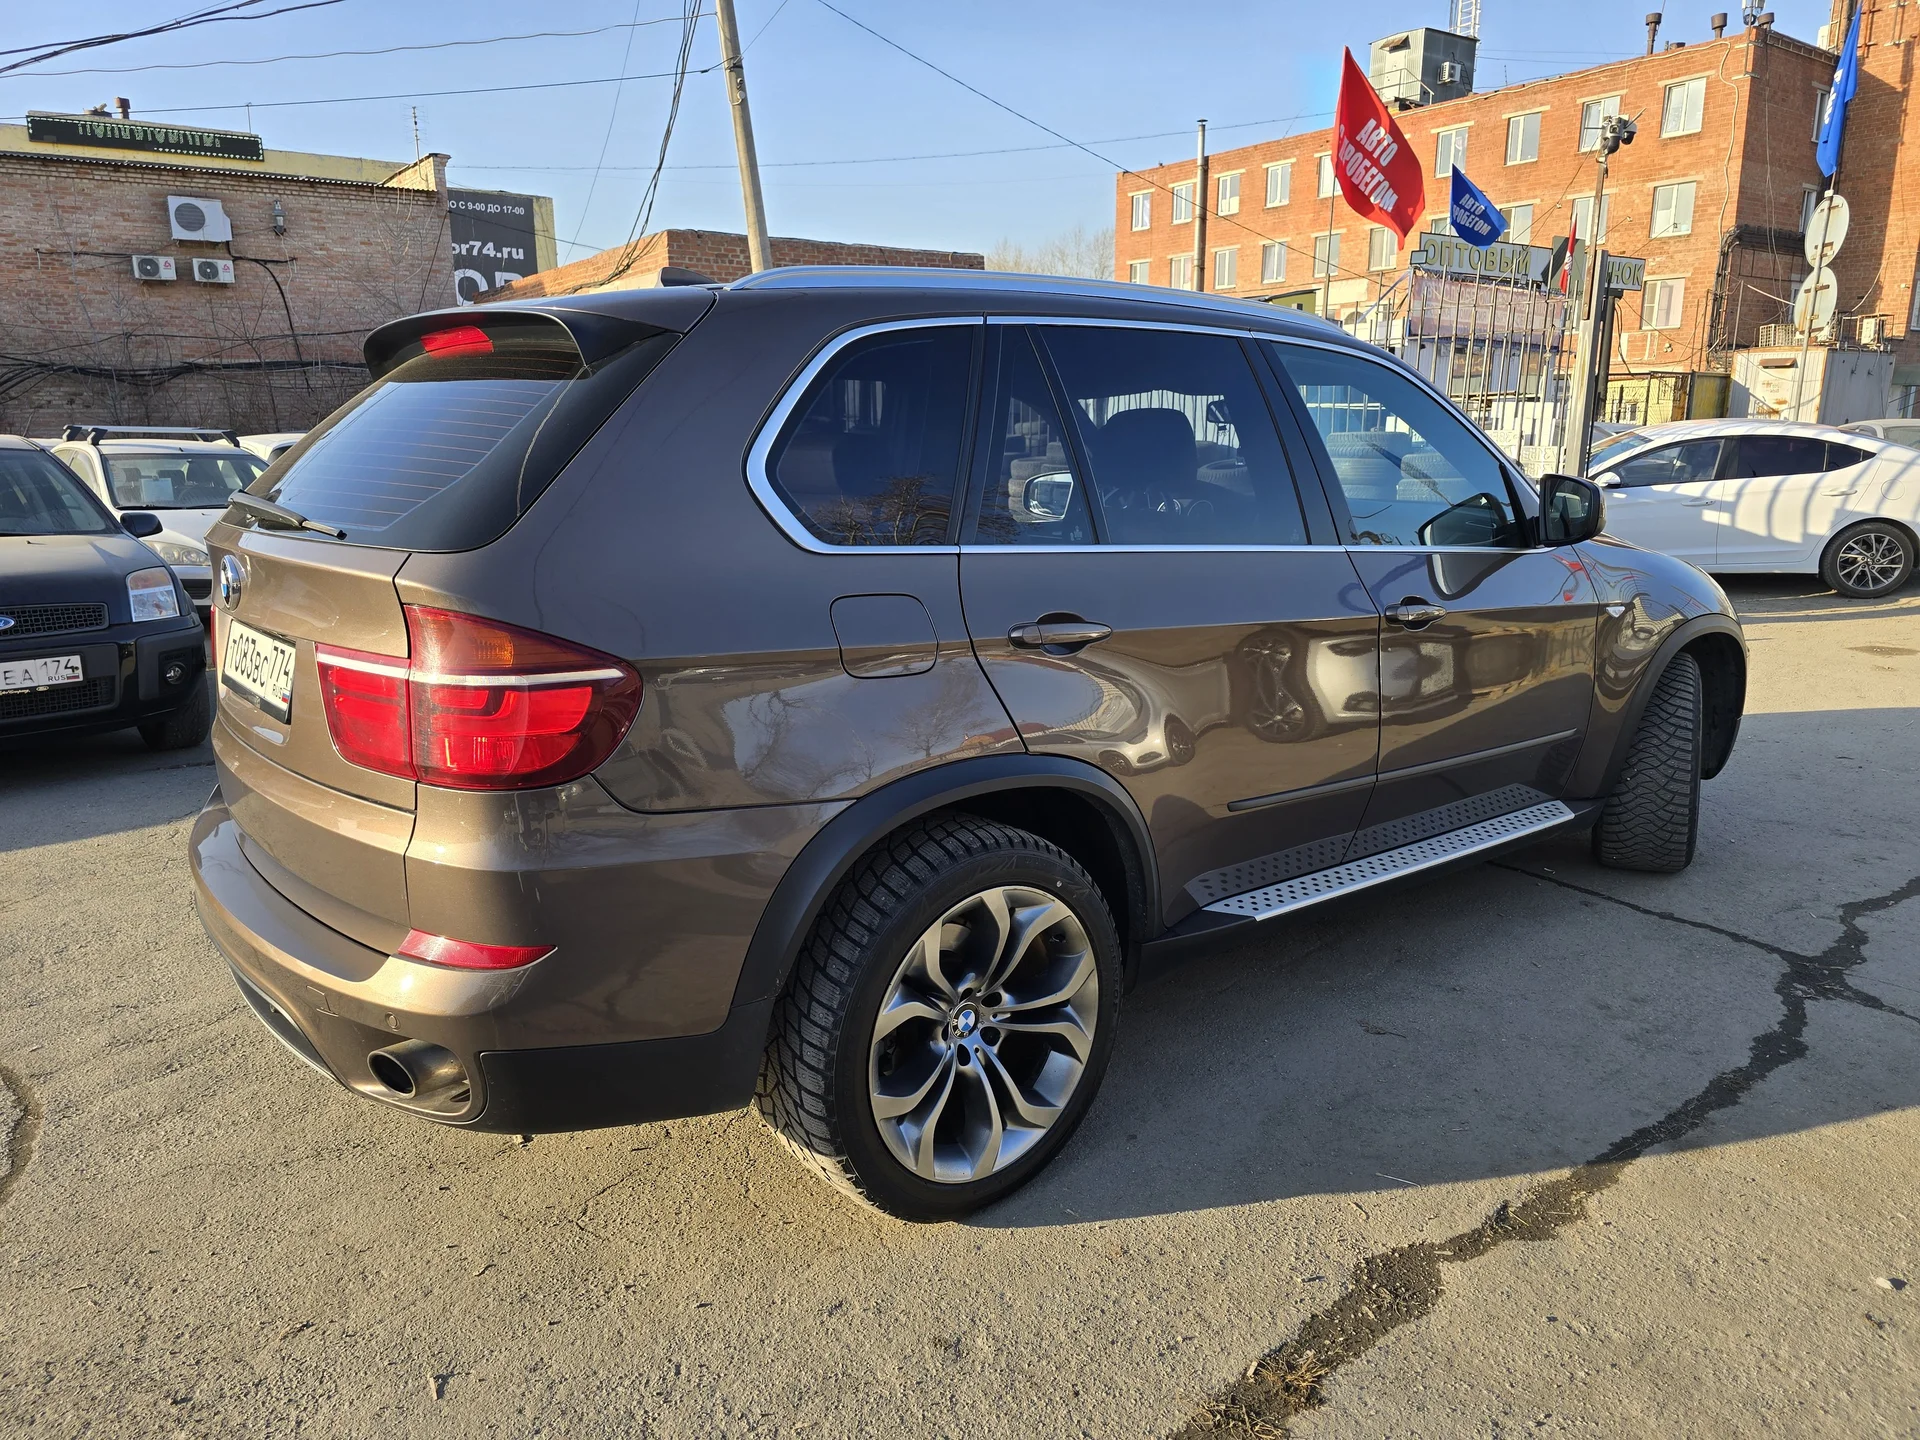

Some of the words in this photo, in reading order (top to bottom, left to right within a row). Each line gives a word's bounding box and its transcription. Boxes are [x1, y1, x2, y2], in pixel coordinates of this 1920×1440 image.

[1355, 118, 1398, 167] АВТО
[459, 201, 466, 209] С
[467, 202, 486, 211] 9-00
[487, 204, 501, 213] ДО
[503, 205, 525, 215] 17-00
[1459, 193, 1485, 215] АВТО
[1424, 239, 1531, 274] ОПТОВЫЙ
[40, 658, 75, 675] 174
[270, 645, 292, 688] 774
[47, 674, 67, 682] RUS
